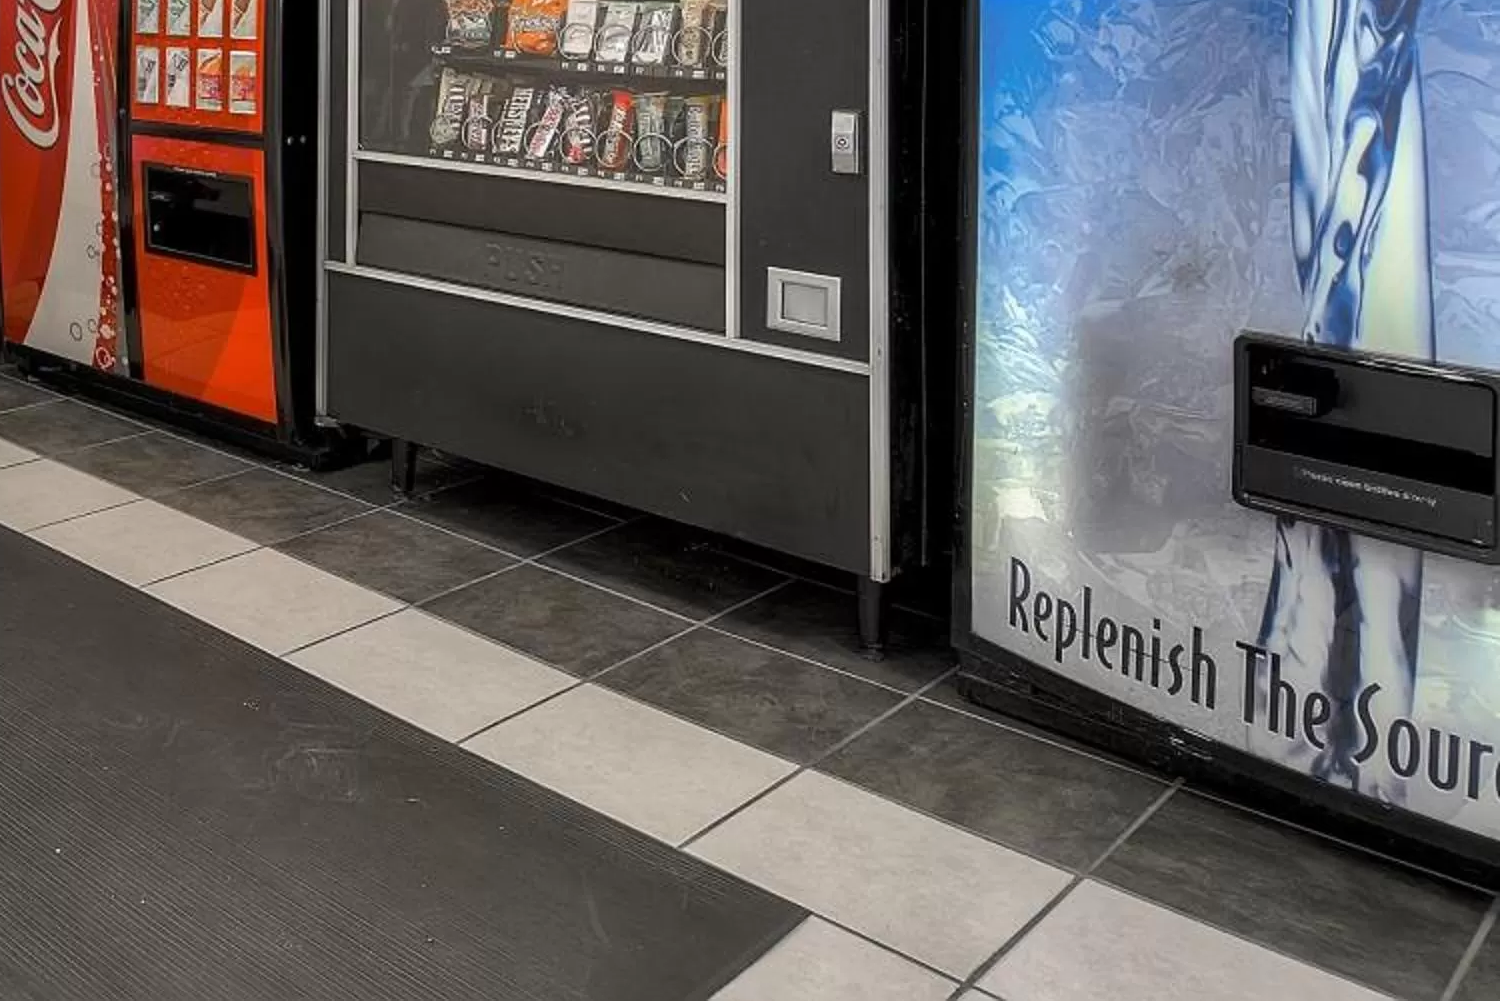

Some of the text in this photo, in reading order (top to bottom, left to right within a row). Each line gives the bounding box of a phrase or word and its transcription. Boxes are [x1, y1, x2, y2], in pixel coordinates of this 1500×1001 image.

[1008, 557, 1500, 801] Replenish The Sour
